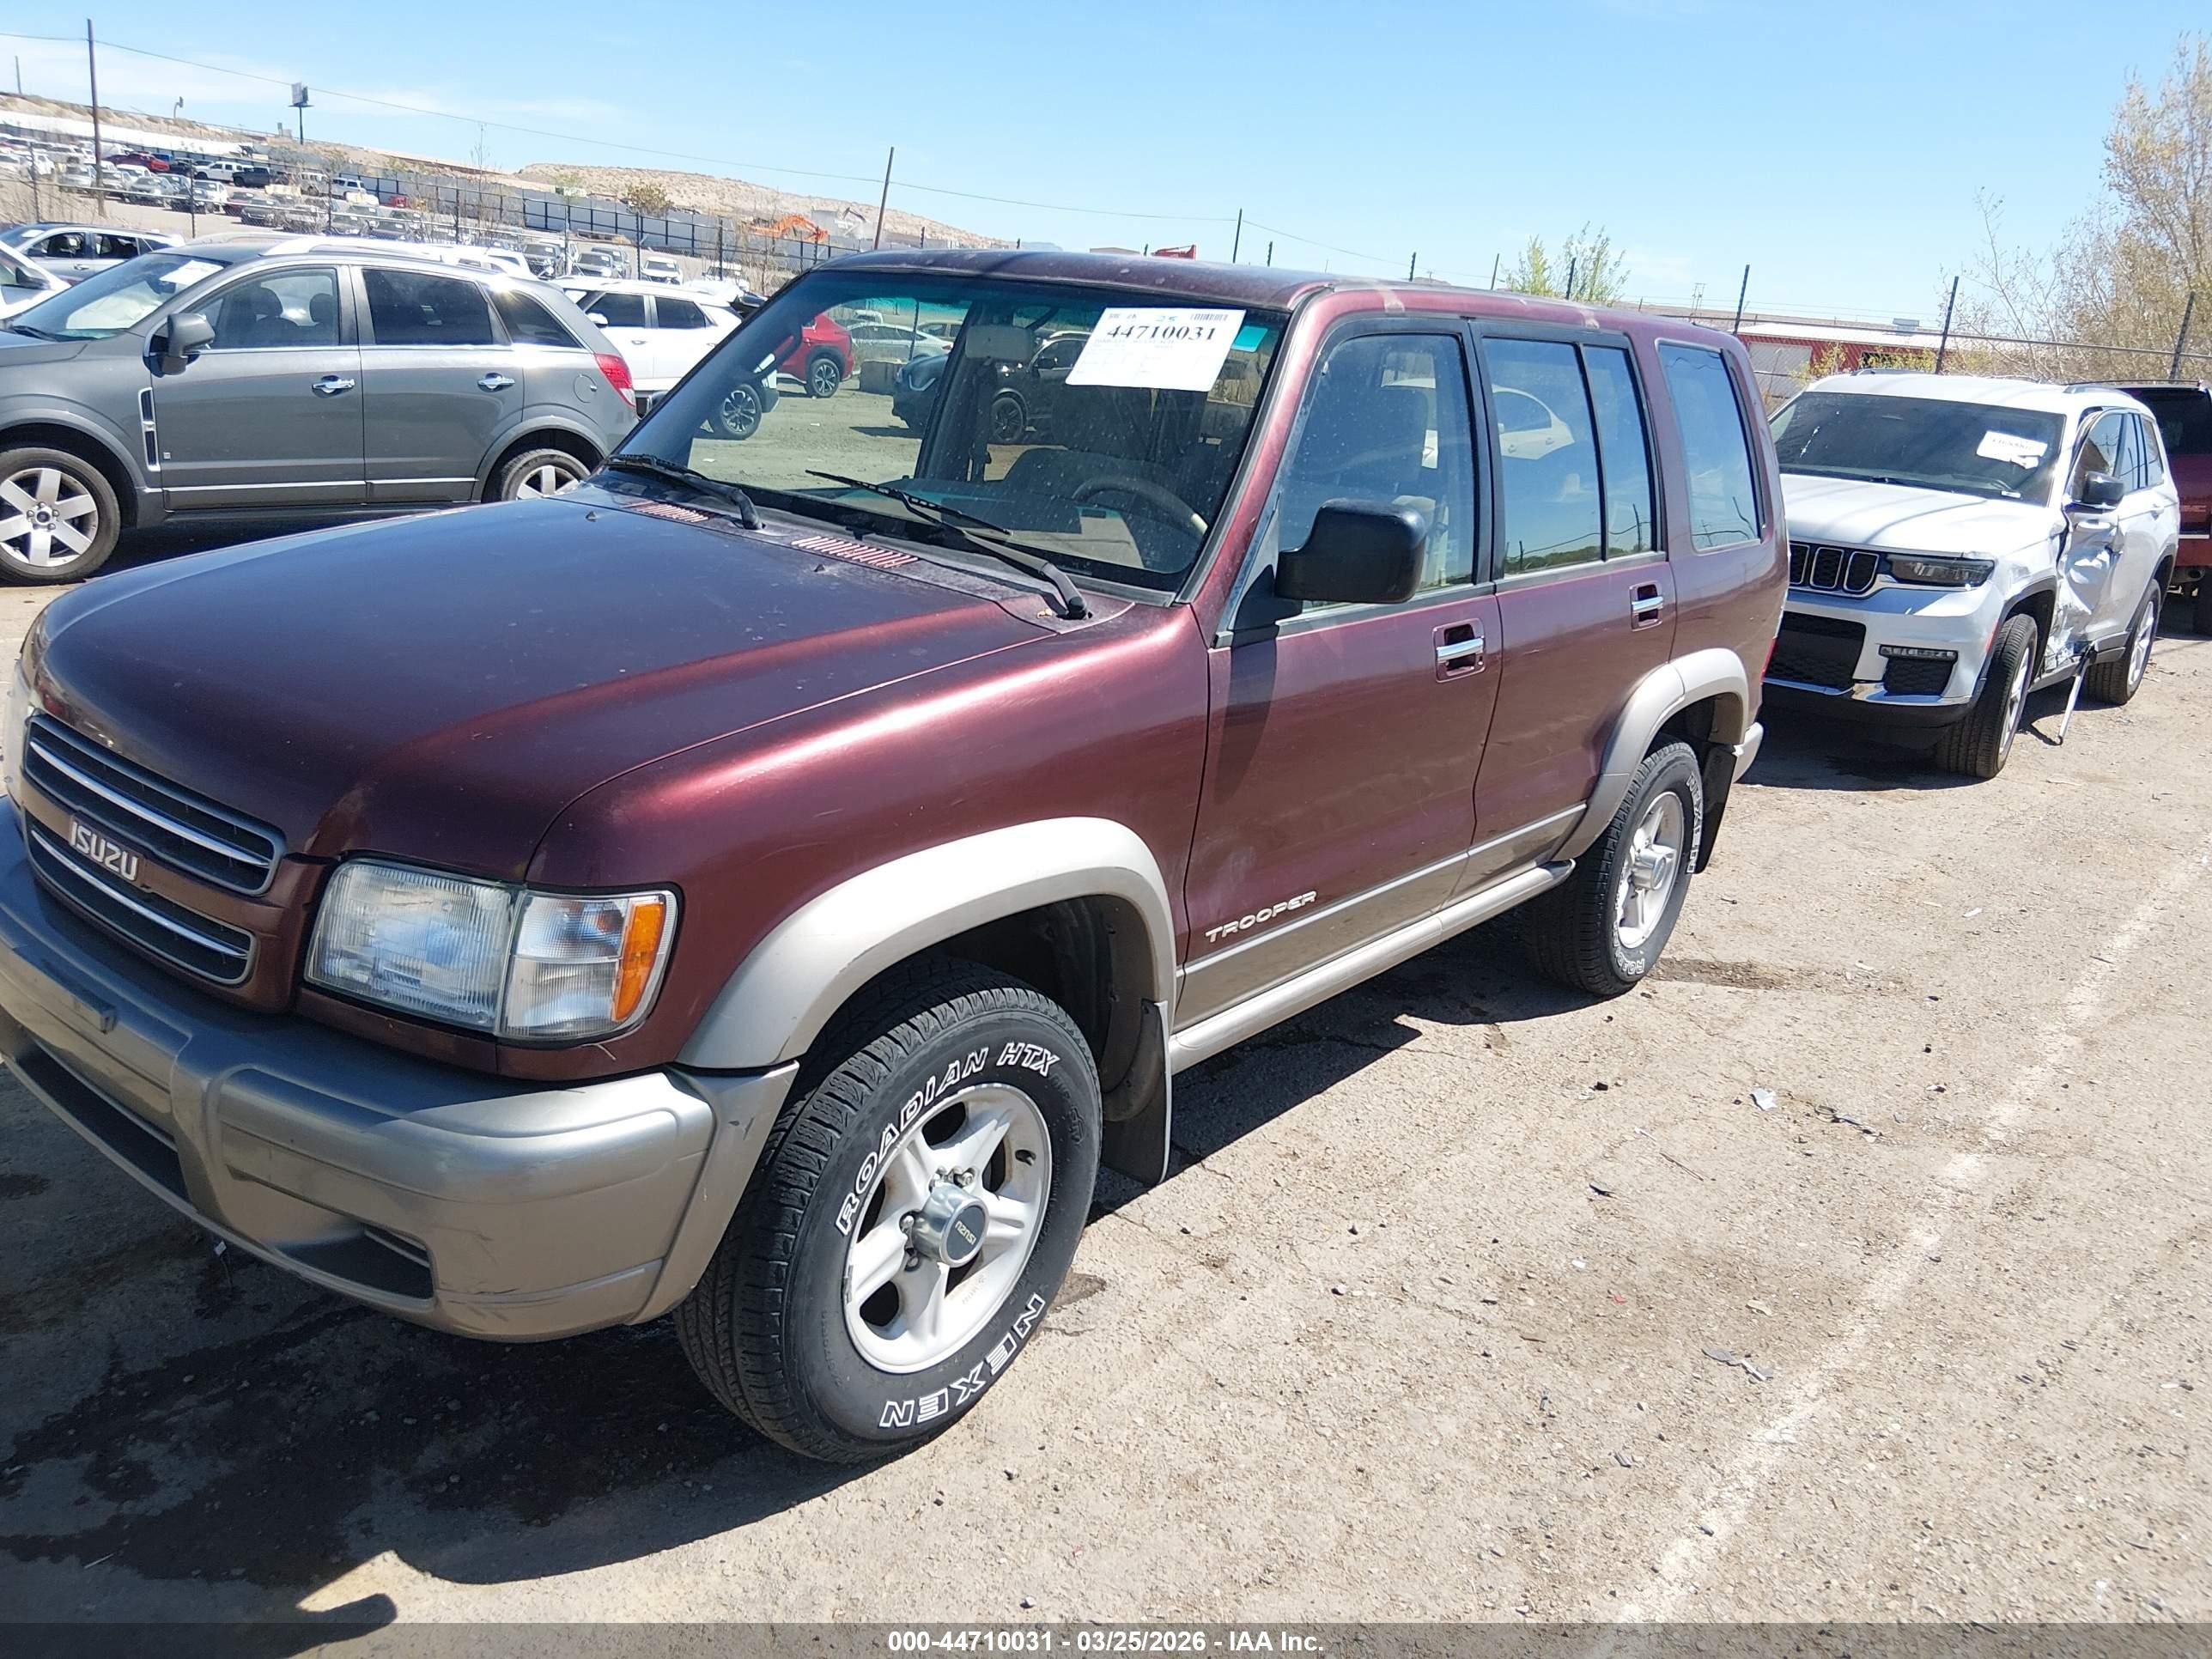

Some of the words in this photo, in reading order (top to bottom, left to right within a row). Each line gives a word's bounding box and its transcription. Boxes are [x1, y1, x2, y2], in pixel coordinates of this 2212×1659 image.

[1107, 325, 1216, 341] 44710031
[70, 821, 138, 881] ISUZU
[1205, 890, 1317, 943] TROOPER
[836, 1046, 988, 1237] ROADIAN
[997, 1042, 1060, 1078] HTX
[954, 1220, 977, 1246] ISUZU
[878, 1292, 1046, 1429] NEXEN
